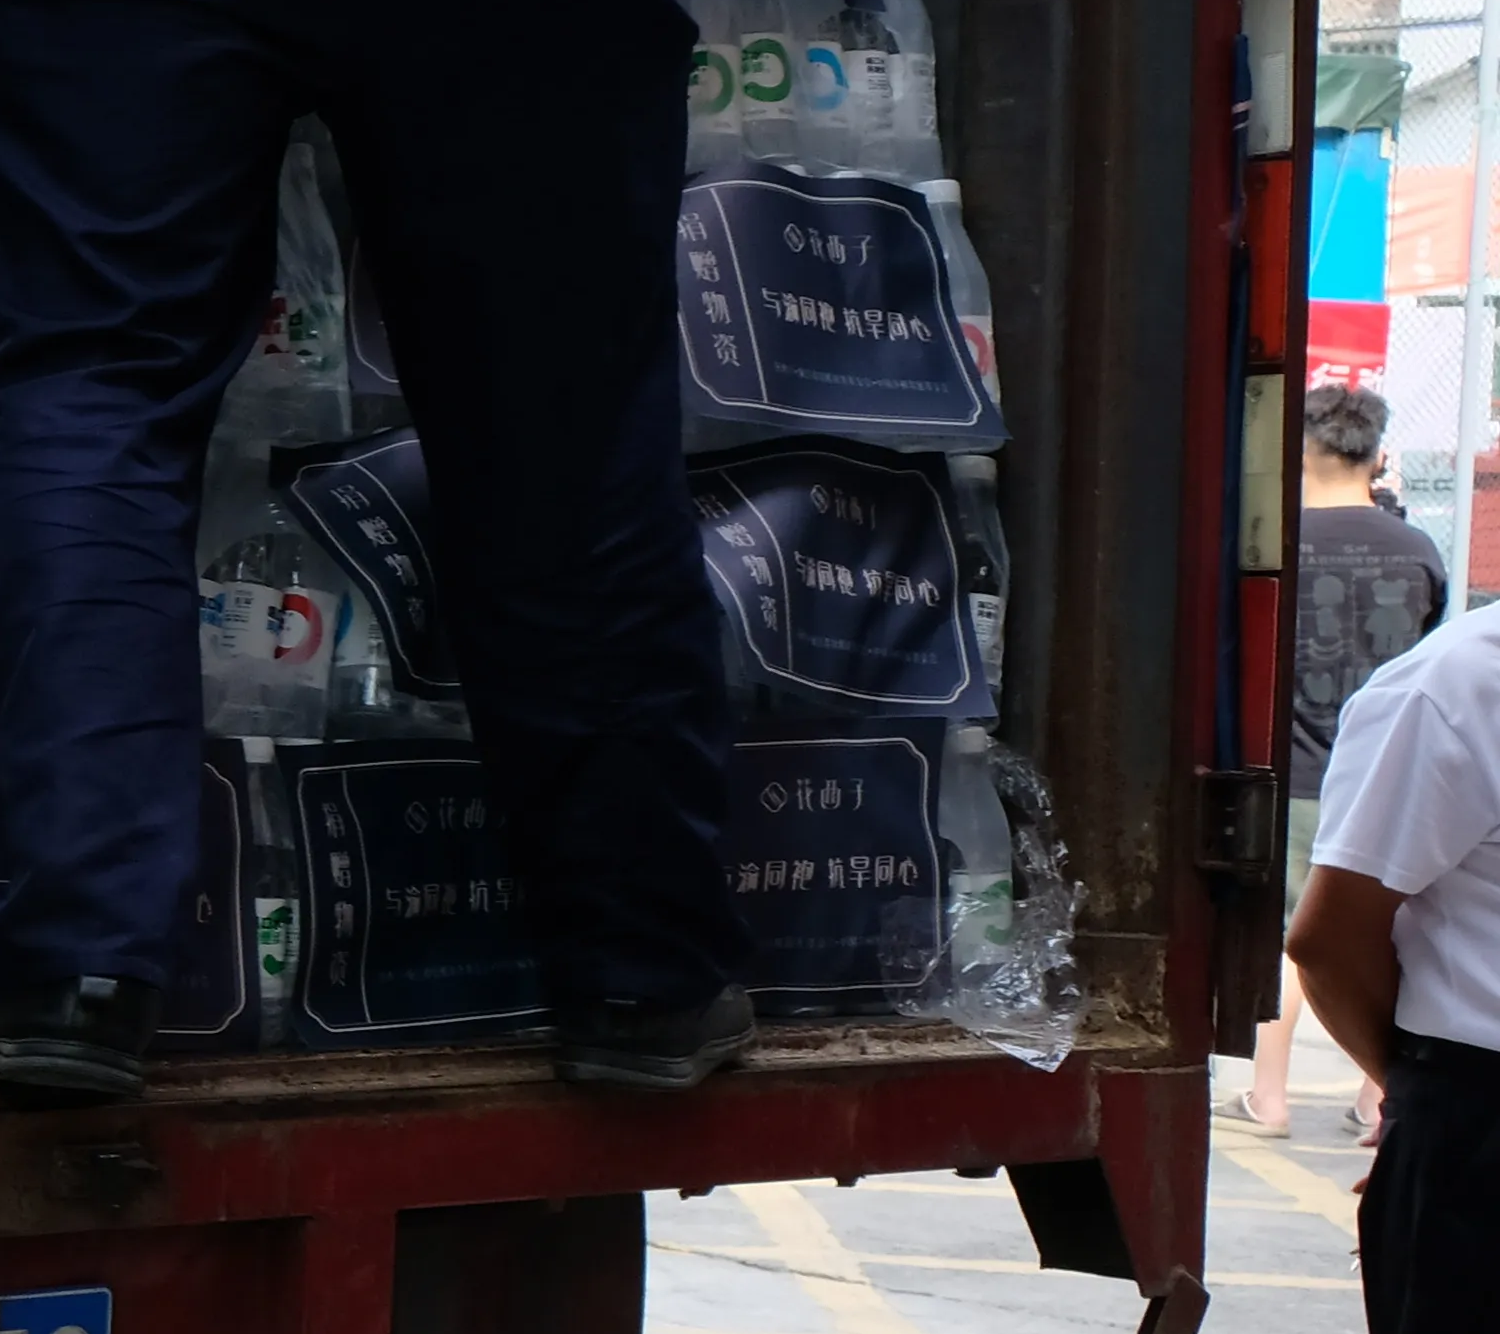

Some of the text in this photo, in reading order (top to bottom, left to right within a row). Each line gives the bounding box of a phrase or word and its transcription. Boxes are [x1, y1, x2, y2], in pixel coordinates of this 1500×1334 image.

[795, 777, 864, 813] 花西子
[726, 855, 920, 894] 渝同袍 抗旱同心
